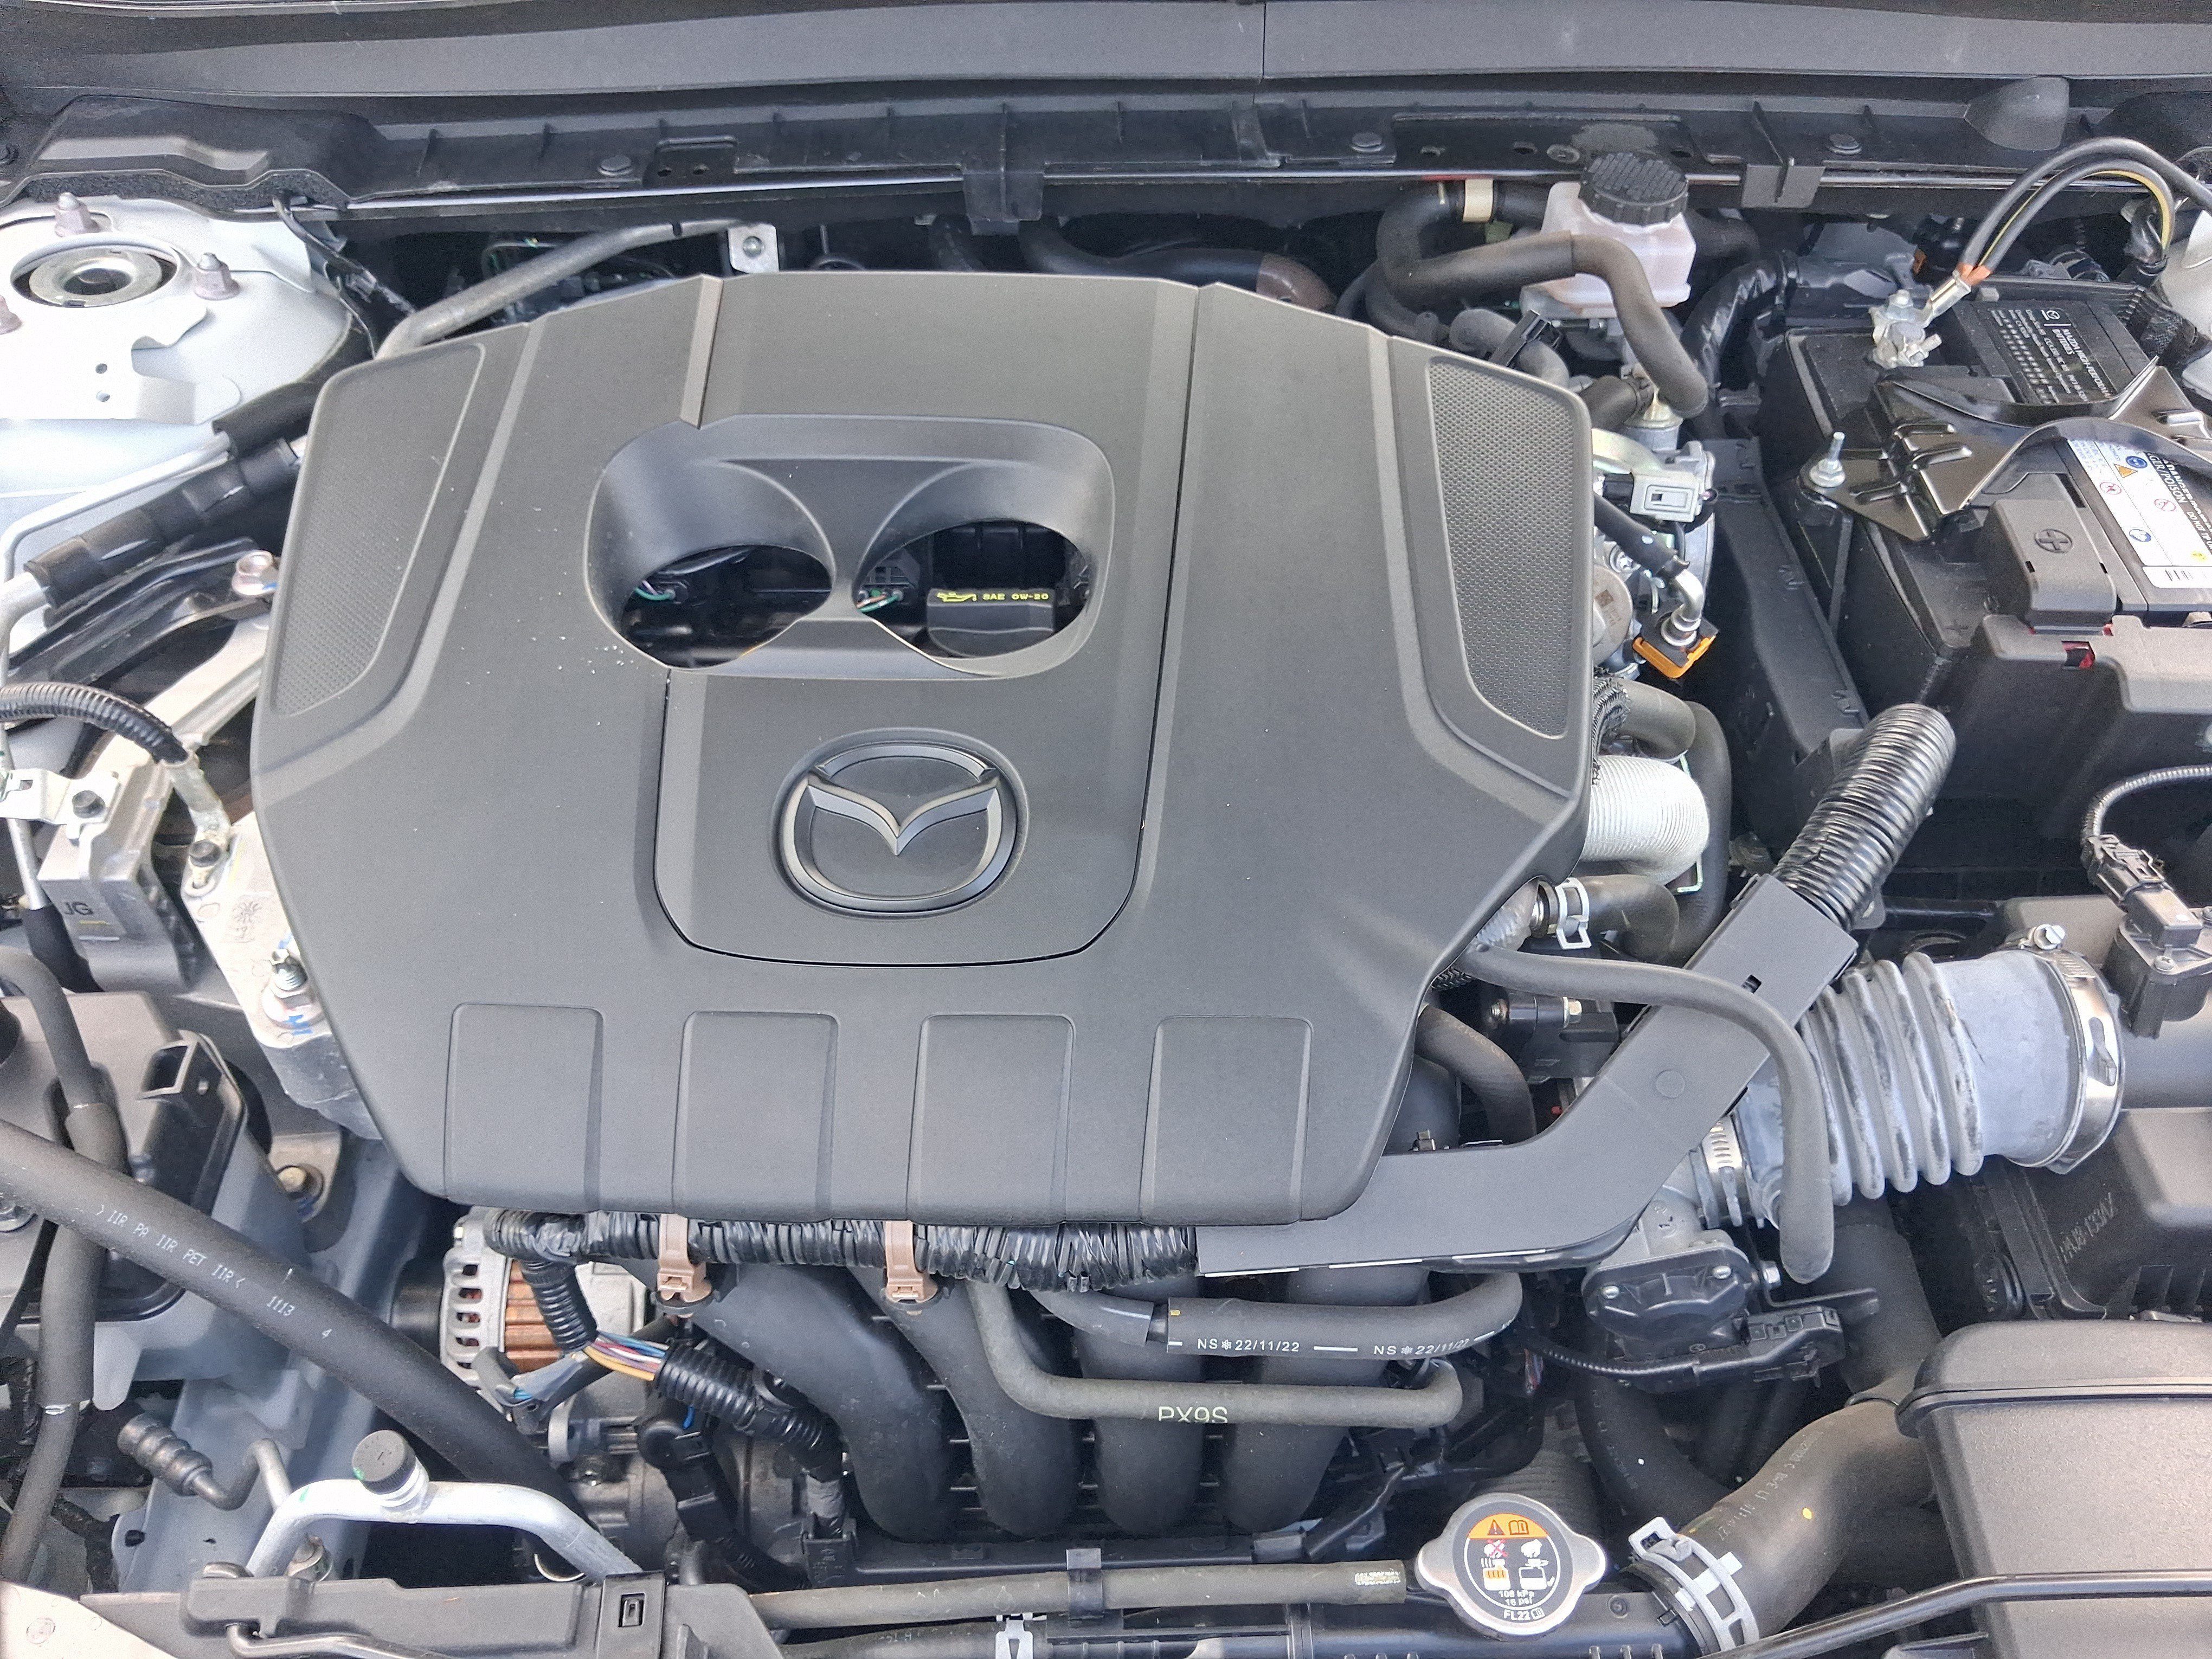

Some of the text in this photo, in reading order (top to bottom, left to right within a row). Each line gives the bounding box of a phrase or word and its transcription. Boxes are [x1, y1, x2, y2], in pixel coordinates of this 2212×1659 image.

[64, 902, 94, 916] JG
[133, 1222, 150, 1238] PA
[156, 1234, 179, 1252] IIR
[182, 1249, 208, 1267] PET
[267, 1296, 295, 1316] 1113
[321, 1328, 333, 1339] 4
[1234, 1339, 1300, 1352] 22/11/22
[1414, 1339, 1469, 1355] 22/11/22
[1158, 1406, 1229, 1424] PX9S
[1516, 1590, 1535, 1598] kPa
[1518, 1597, 1533, 1606] psi
[1503, 1609, 1531, 1621] FL22
